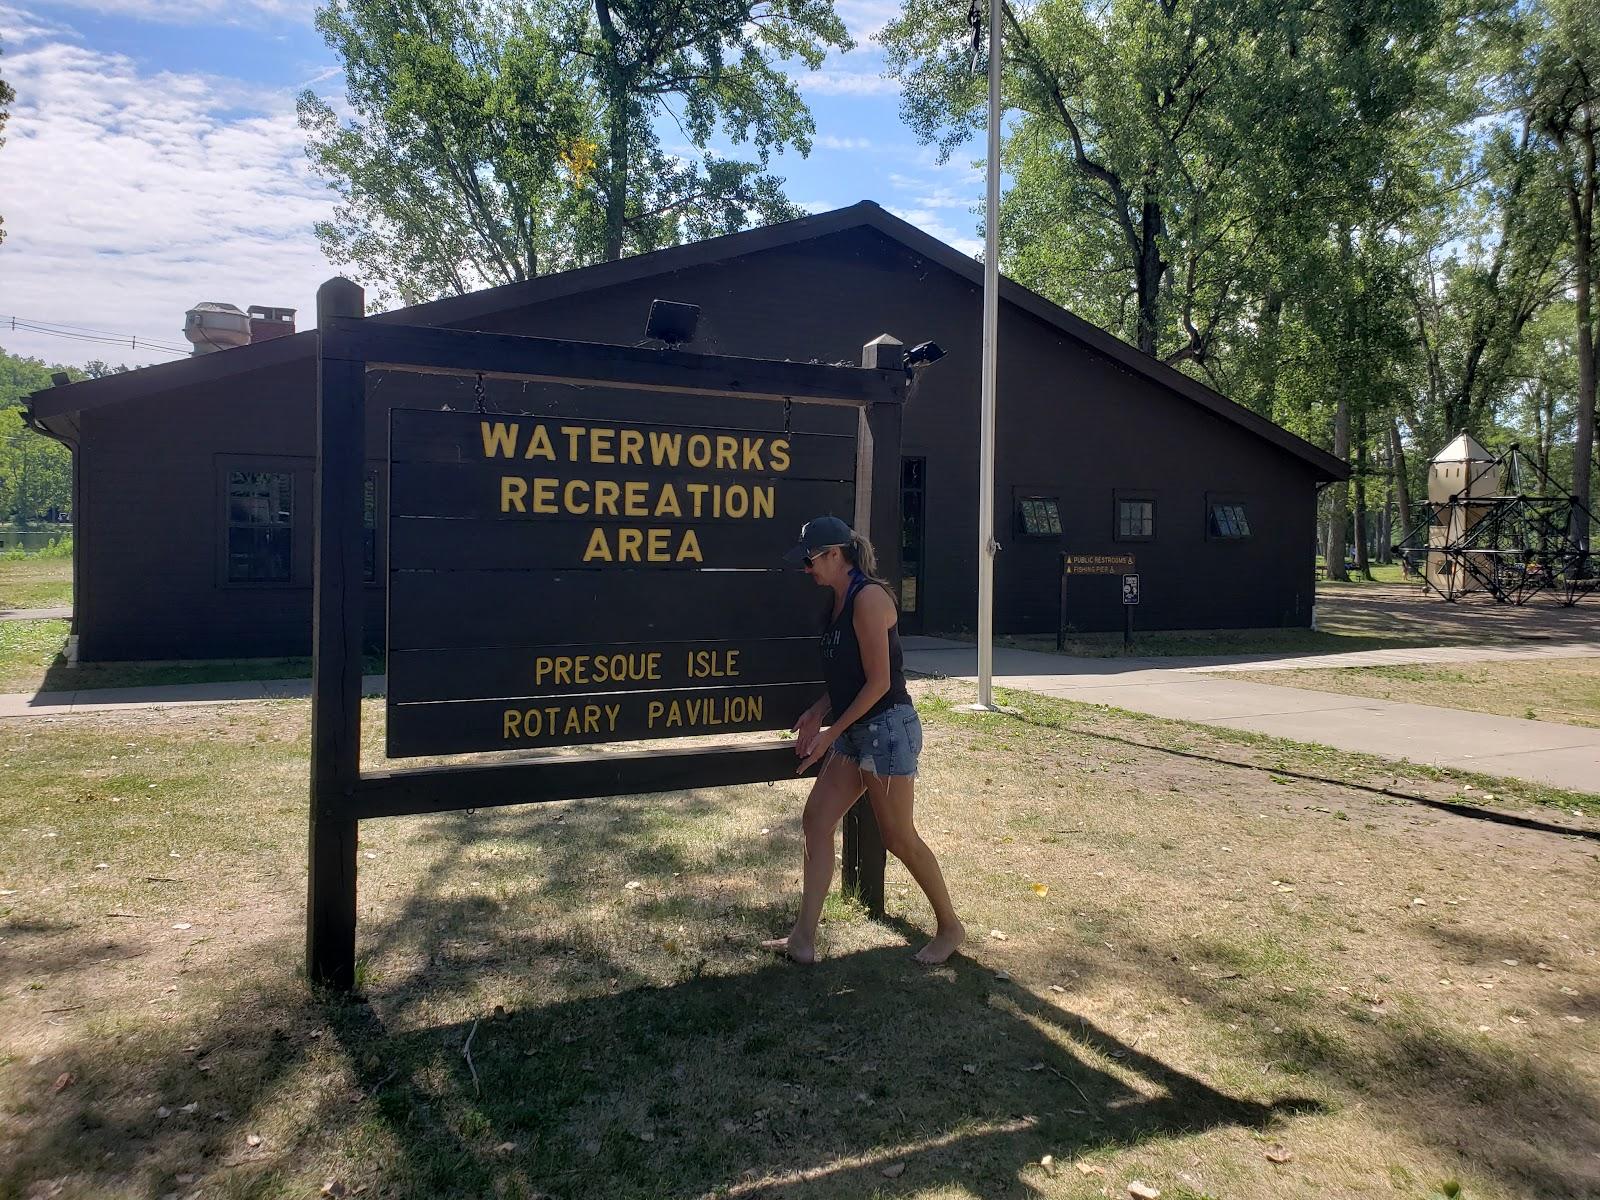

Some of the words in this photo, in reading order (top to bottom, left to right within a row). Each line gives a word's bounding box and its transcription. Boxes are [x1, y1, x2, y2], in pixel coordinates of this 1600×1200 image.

[481, 421, 792, 472] WATERWORKS
[500, 476, 775, 519] RECREATION
[583, 527, 704, 562] AREA
[1073, 556, 1093, 564] PUBLIC
[1094, 556, 1127, 564] RESTROOMS
[535, 652, 662, 686] PRESQUE
[687, 649, 740, 678] ISLE
[503, 703, 621, 739] ROTARY
[648, 695, 764, 728] PAVILION
